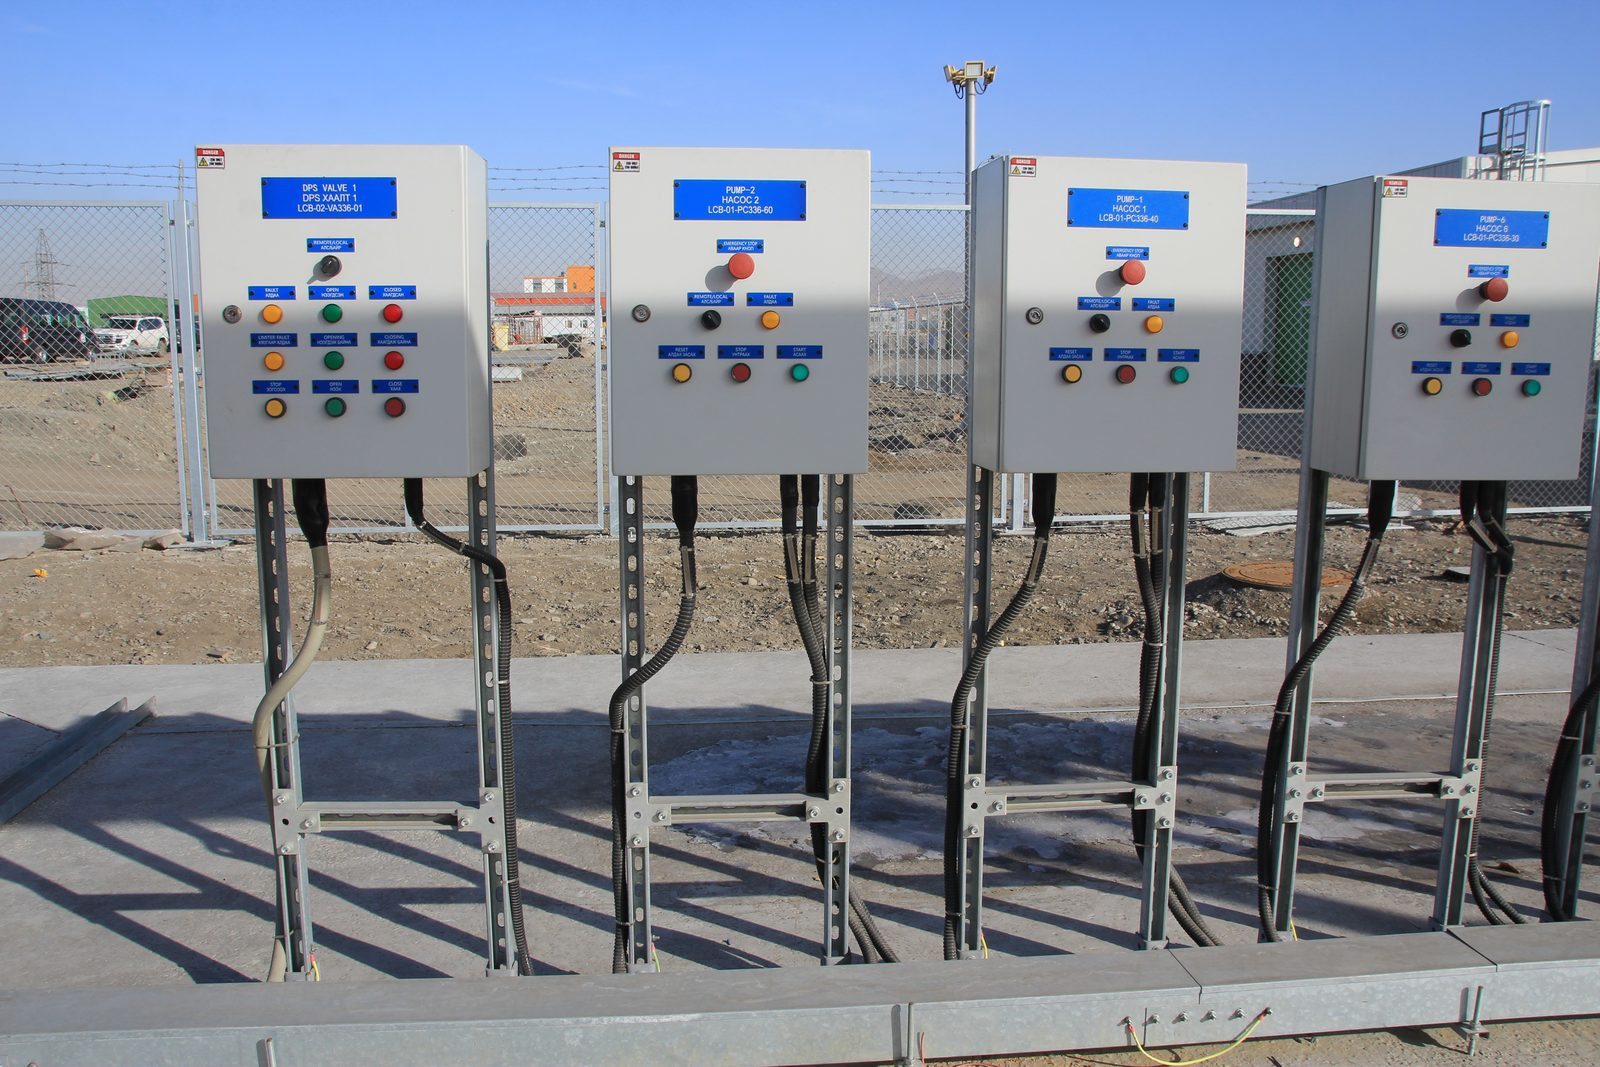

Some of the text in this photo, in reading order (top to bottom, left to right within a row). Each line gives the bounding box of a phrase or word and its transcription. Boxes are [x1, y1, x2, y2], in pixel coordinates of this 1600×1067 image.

[302, 184, 356, 192] DPS VALVE 1
[726, 186, 755, 194] PUMP-2
[302, 194, 320, 202] DPS
[353, 194, 357, 202] 1
[298, 204, 362, 212] LCB-02-VA336-01
[1099, 214, 1158, 223] LCB-01-PC336-40
